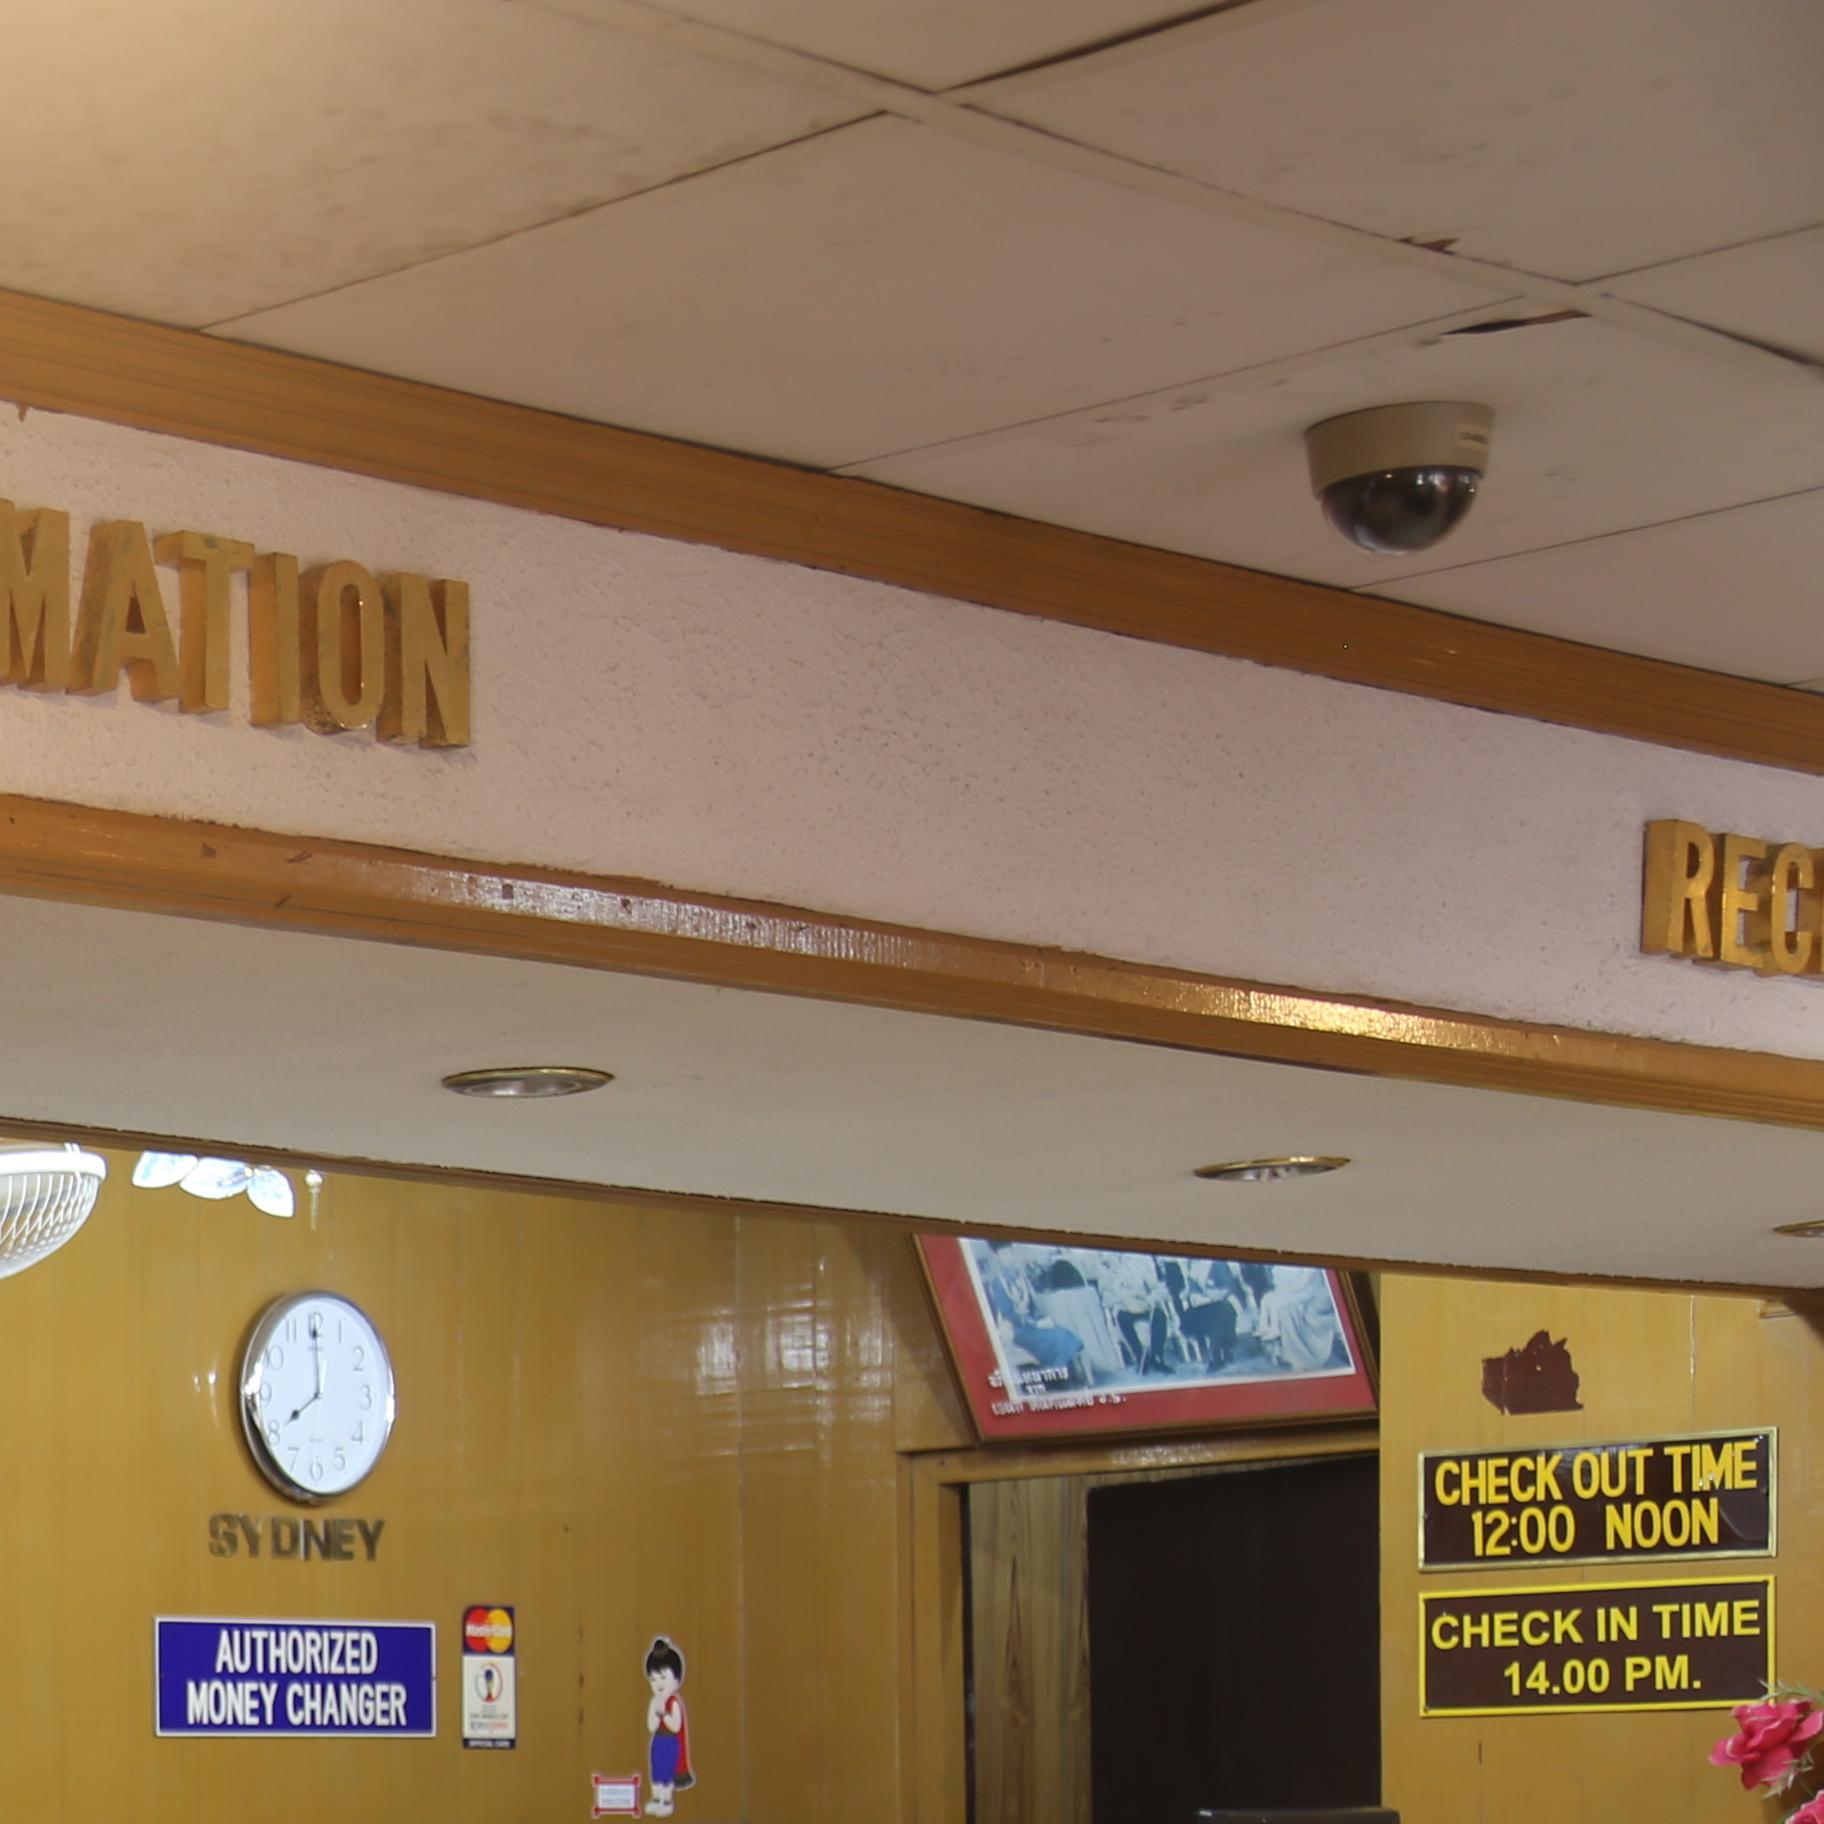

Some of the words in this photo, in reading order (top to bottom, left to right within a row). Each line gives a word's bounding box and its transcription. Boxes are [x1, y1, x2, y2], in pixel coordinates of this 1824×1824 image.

[1640, 819, 1824, 977] REC
[1435, 1453, 1563, 1506] CHECK
[1572, 1449, 1653, 1499] OUT
[1664, 1441, 1757, 1493] TIME
[209, 1513, 385, 1561] SYDNEY
[1472, 1505, 1575, 1557] 12:00
[1605, 1498, 1718, 1550] NOON
[1432, 1608, 1583, 1650] CHECK
[1597, 1605, 1638, 1643] IN
[1653, 1600, 1761, 1639] TIME
[215, 1629, 378, 1674] AUTHORIZED
[1504, 1658, 1610, 1696] 14.00
[1625, 1655, 1702, 1691] PM.
[187, 1680, 278, 1726] MONEY
[286, 1683, 407, 1726] CHANGER
